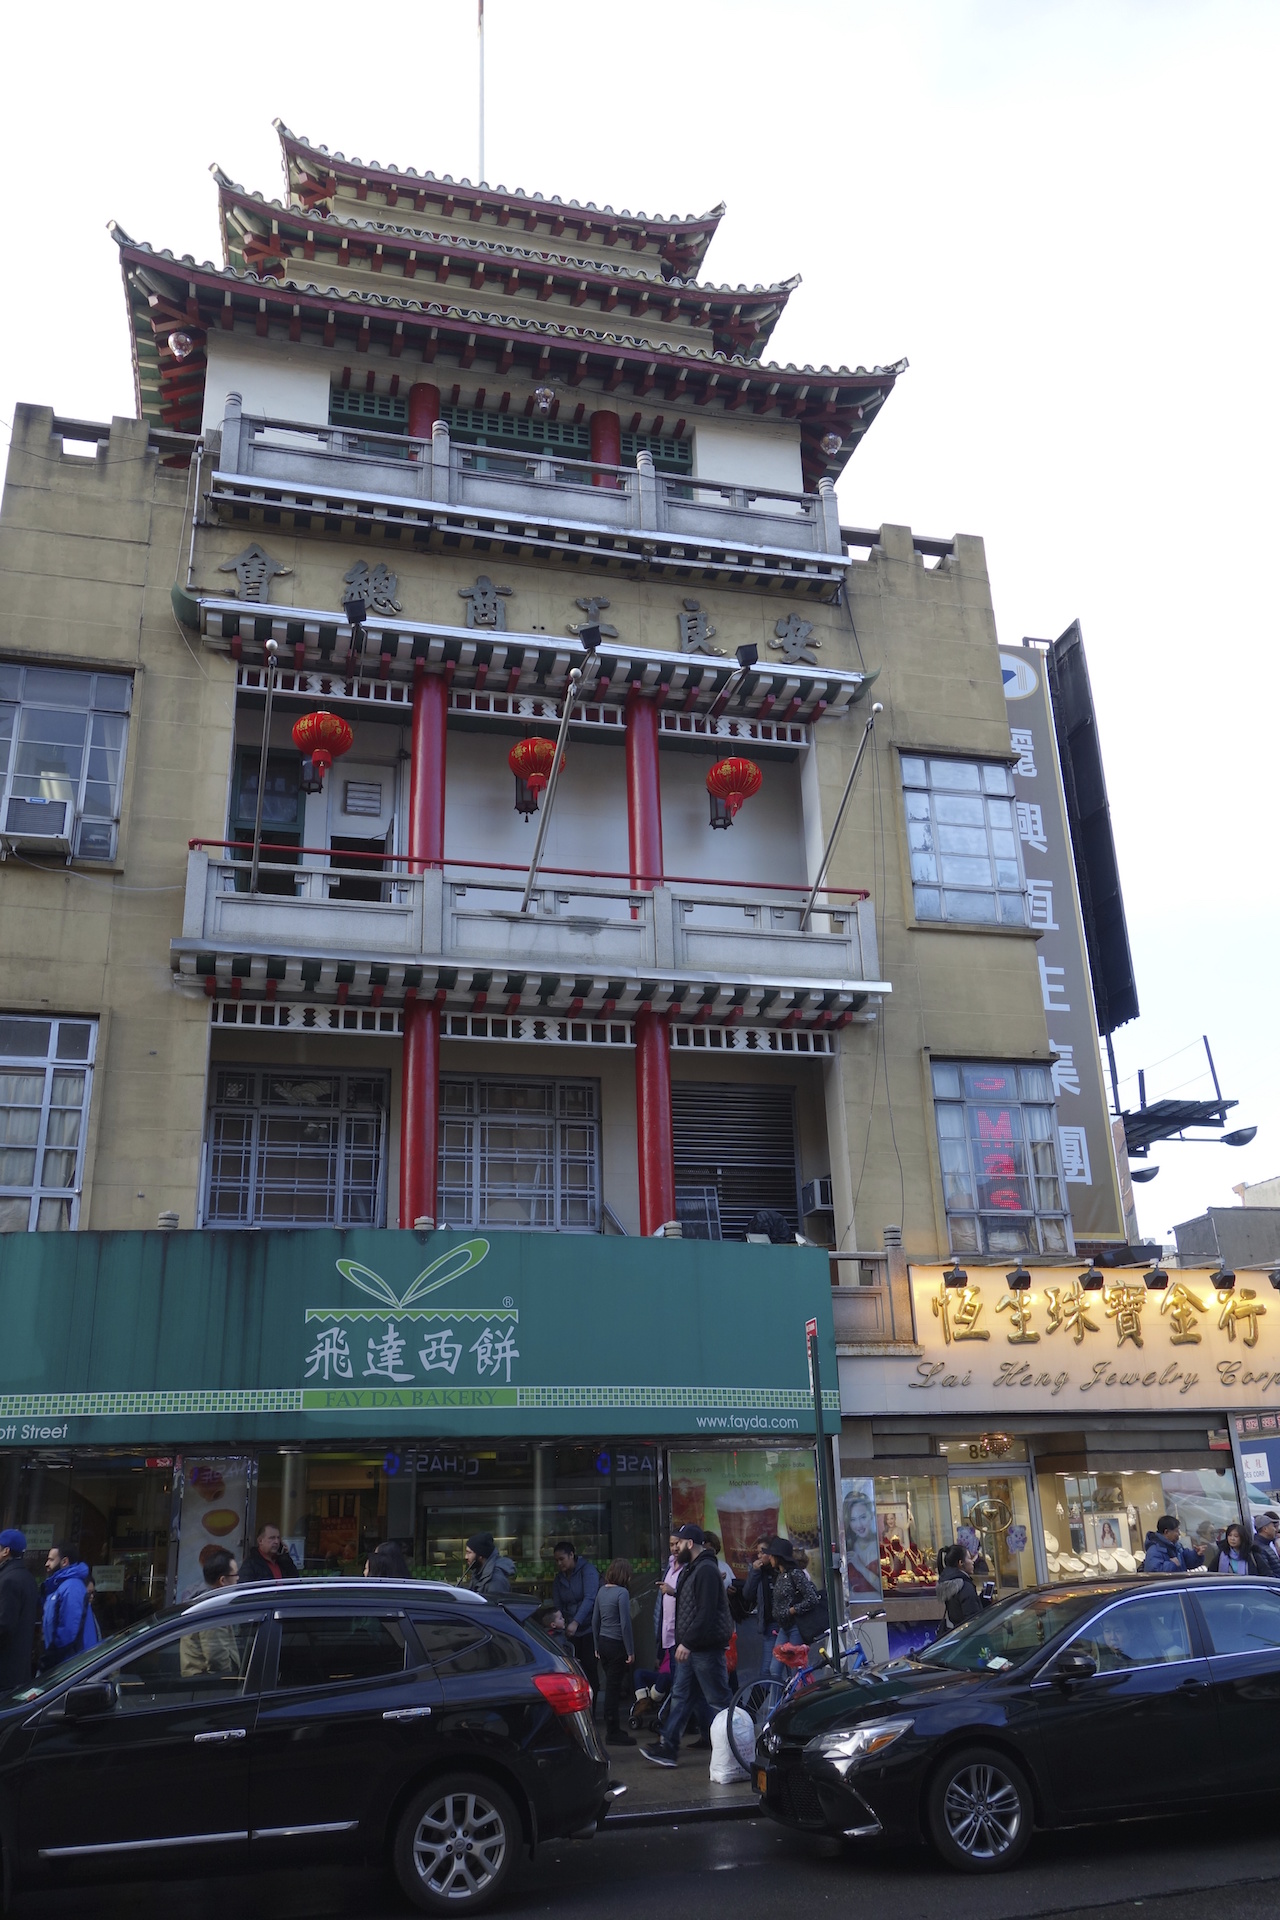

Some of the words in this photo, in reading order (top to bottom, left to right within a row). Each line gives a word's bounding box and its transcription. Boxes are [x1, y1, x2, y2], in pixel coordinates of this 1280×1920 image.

[303, 1323, 520, 1383] 飛達西餅
[908, 1360, 973, 1389] Lai
[993, 1359, 1070, 1396] Heng
[1079, 1360, 1199, 1395] Jewelry
[325, 1391, 366, 1407] FAY
[371, 1391, 405, 1407] DA
[411, 1390, 498, 1406] BAKERY
[696, 1414, 799, 1431] www.fayda.com
[20, 1423, 69, 1440] Street
[968, 1444, 989, 1460] 85
